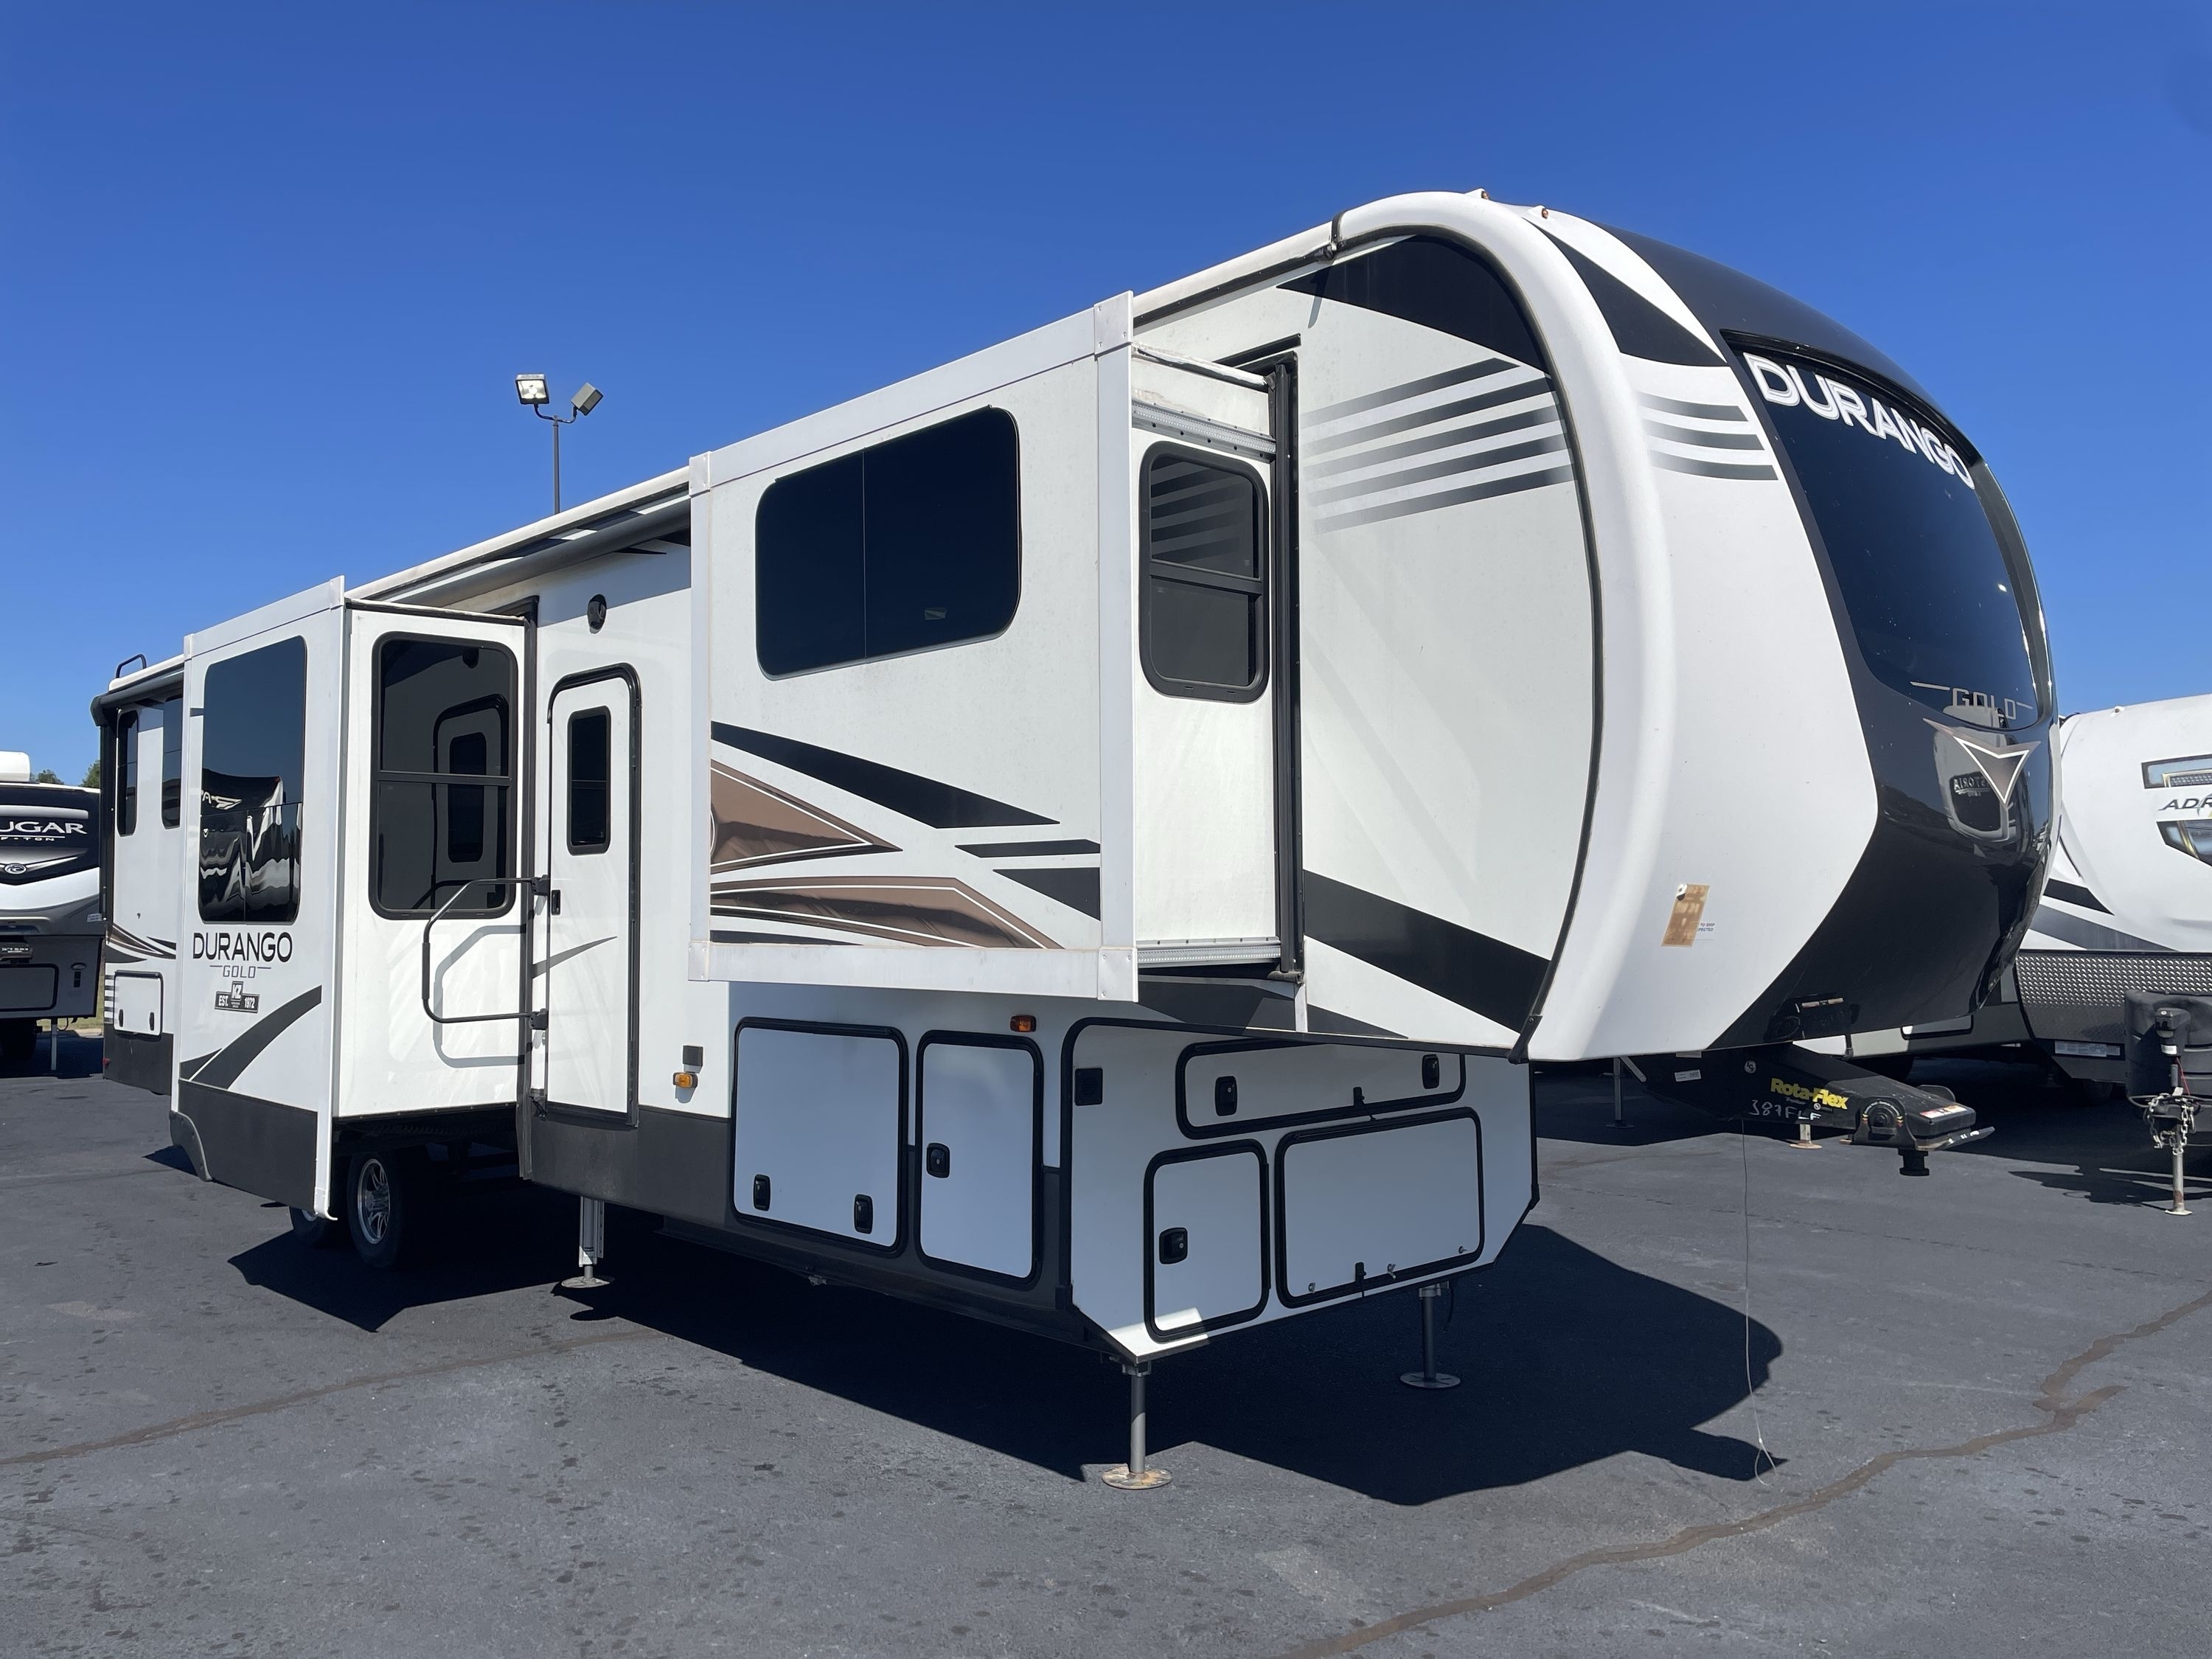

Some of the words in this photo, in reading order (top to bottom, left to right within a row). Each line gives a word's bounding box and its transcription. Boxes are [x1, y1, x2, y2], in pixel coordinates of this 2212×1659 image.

[1742, 352, 1976, 490] DURANGO
[1952, 687, 2017, 720] GOLD
[192, 931, 293, 963] DURANGO
[223, 965, 257, 978] GOLD
[218, 995, 229, 1007] EST.
[244, 997, 256, 1009] 1972
[232, 984, 242, 999] KZ
[1770, 1077, 1849, 1110] Rota-Flex
